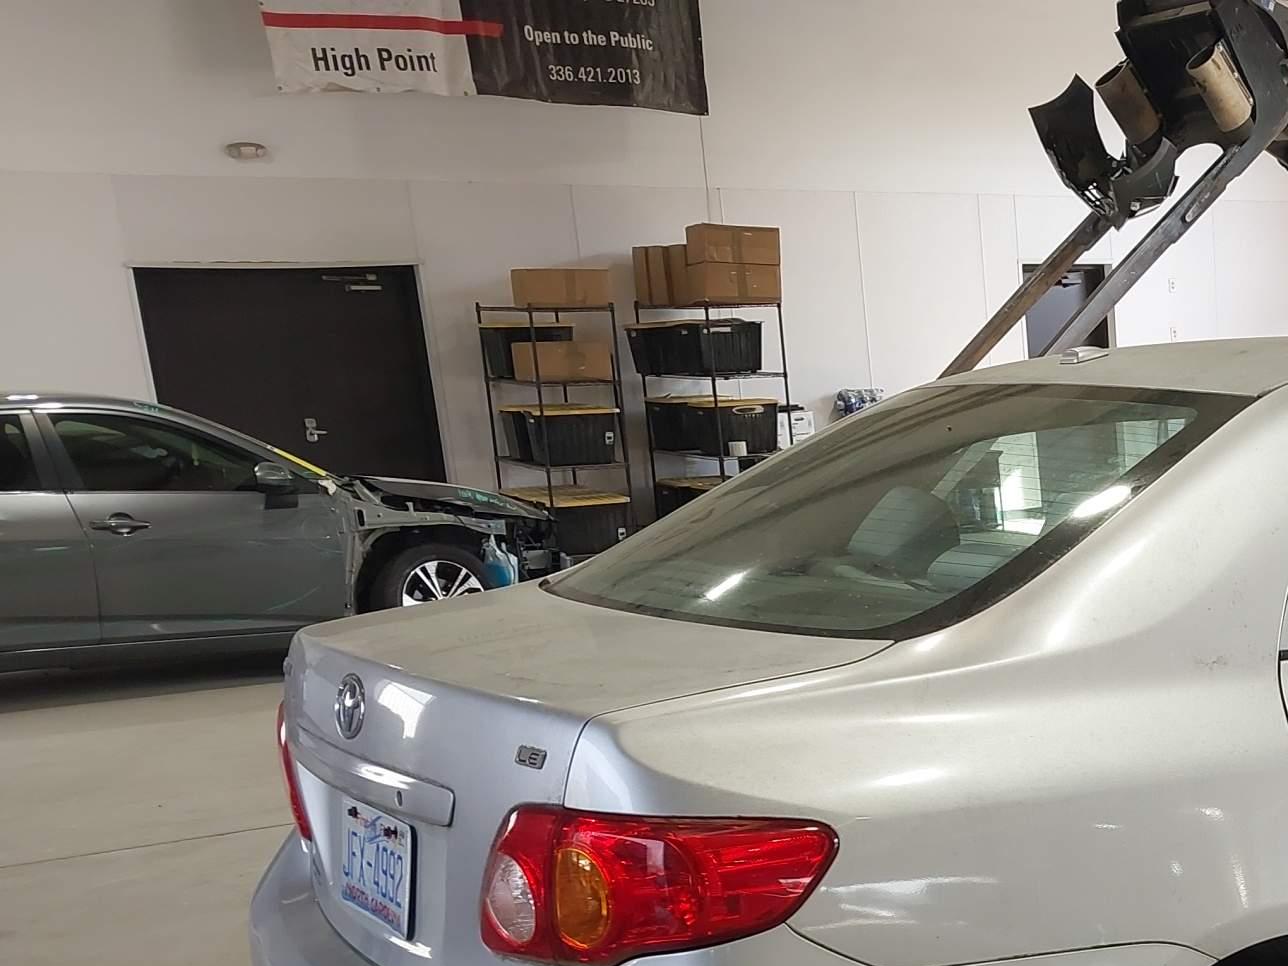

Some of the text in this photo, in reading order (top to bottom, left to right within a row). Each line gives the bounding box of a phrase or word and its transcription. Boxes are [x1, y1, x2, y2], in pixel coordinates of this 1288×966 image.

[523, 24, 654, 51] Open to the Public
[311, 47, 439, 77] High Point
[548, 64, 641, 85] 336.421.2013
[342, 827, 404, 909] JFX-4992
